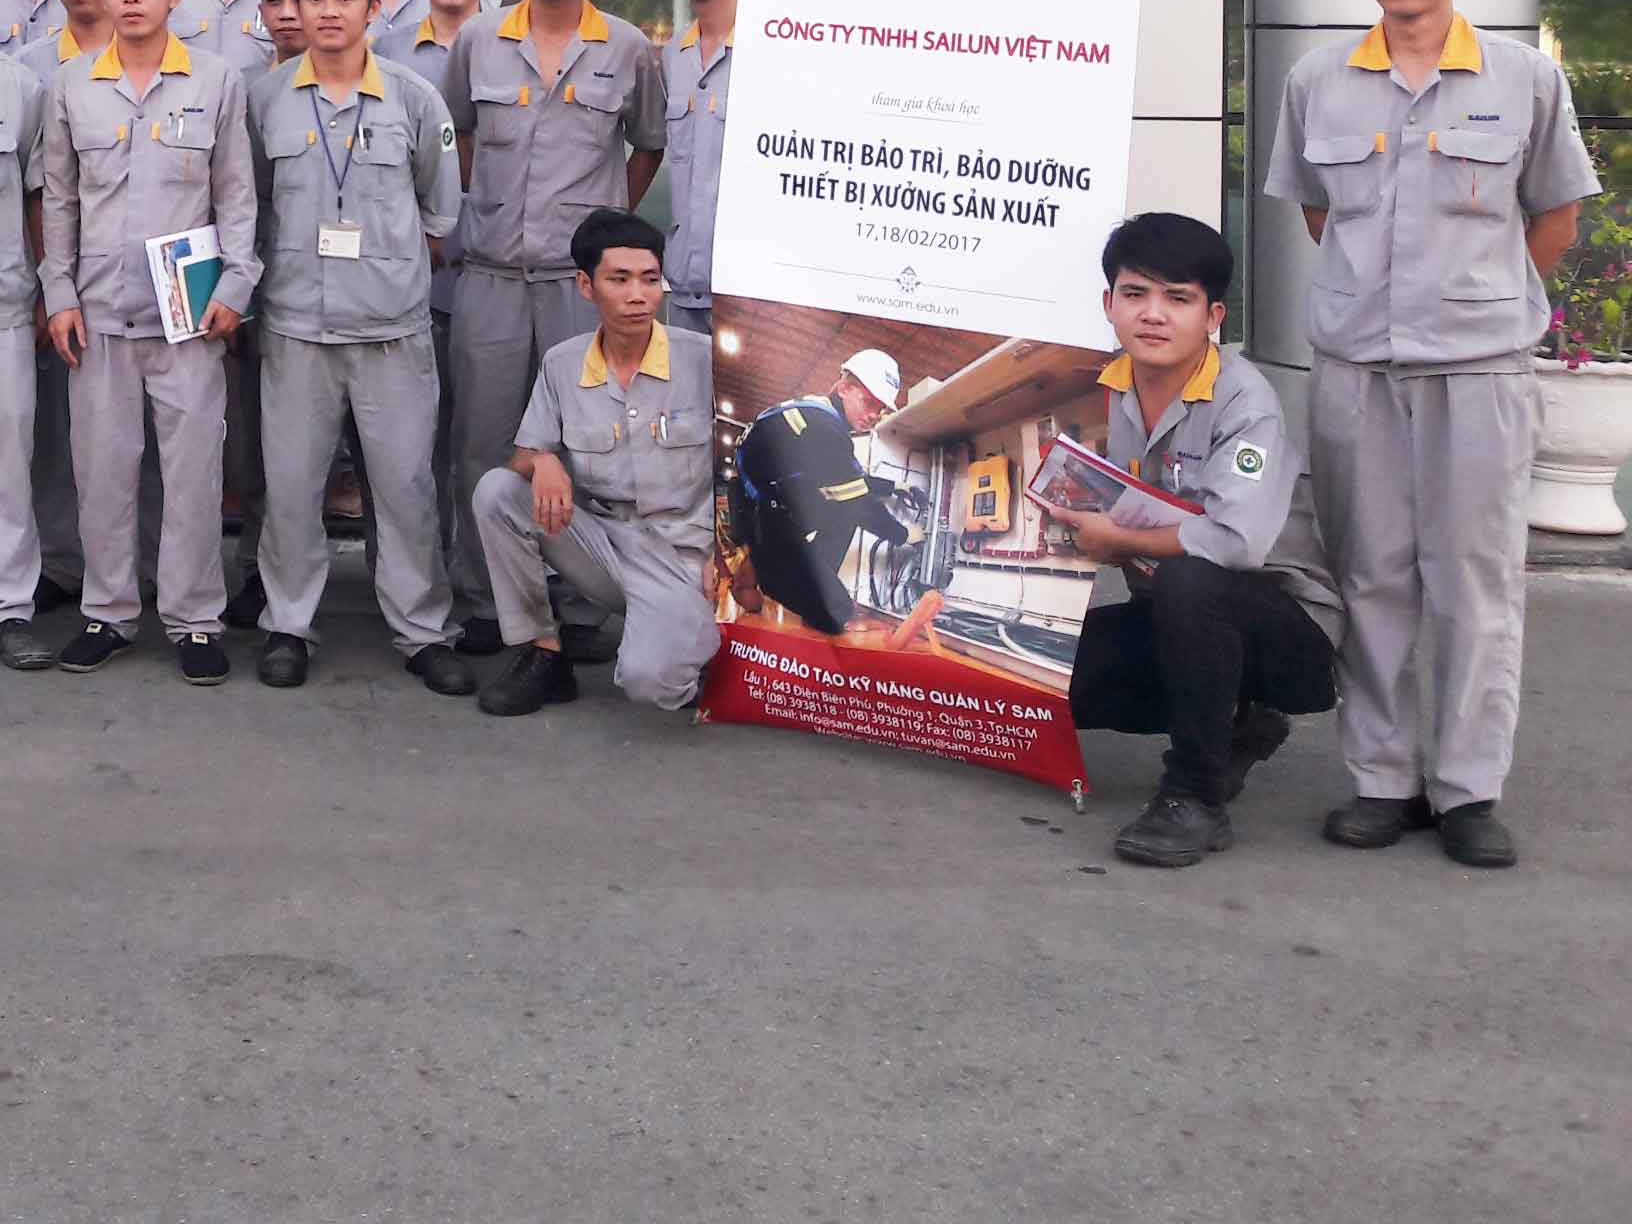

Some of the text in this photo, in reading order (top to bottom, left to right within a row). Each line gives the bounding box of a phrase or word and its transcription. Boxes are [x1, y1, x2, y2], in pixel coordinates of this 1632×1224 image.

[764, 16, 1111, 65] CÔNG TY TNHH SAILUN VIỆT NAM
[871, 90, 902, 108] tham
[757, 129, 1091, 192] QUẢN TRỊ BẢO TRÌ, BẢO DƯỠNG
[779, 170, 1060, 229] THIẾT BỊ XƯỞNG SẢN XUẤT
[856, 292, 960, 317] www.sam.edu.vn
[729, 640, 1053, 721] TRƯỜNG ĐÀO TẠO KỸ NĂNG QUẢN LÝ SAM
[771, 680, 791, 694] 643
[793, 684, 819, 700] Điện
[821, 691, 846, 705] Biên
[764, 704, 798, 720] Email:
[902, 730, 1016, 761] tuvan@sam.edu.vn
[766, 691, 787, 706] (08)
[789, 697, 838, 715] 3938118
[847, 708, 868, 723] (08)
[926, 722, 950, 737] Fax:
[953, 727, 976, 742] (08)
[979, 732, 1032, 751] 3938117
